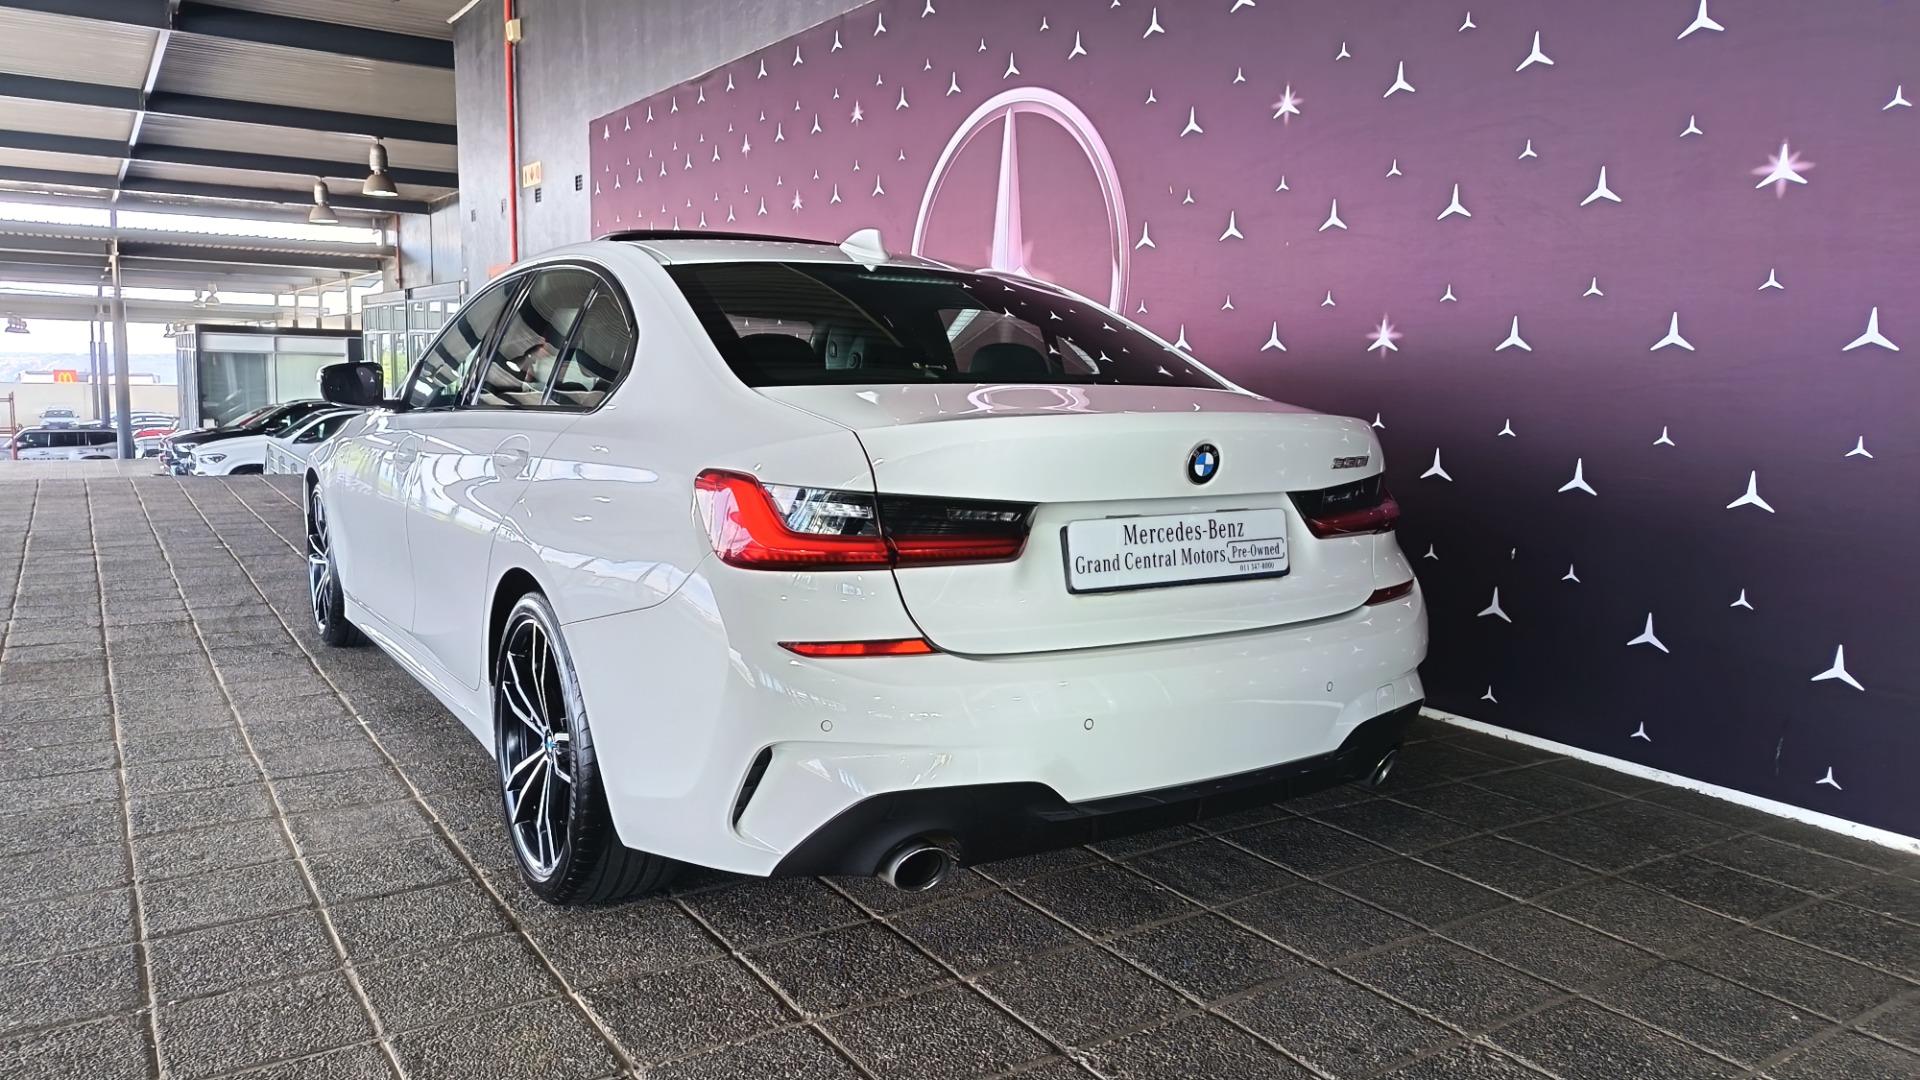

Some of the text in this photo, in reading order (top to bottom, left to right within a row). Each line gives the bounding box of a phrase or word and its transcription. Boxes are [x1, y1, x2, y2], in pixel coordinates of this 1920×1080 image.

[1123, 519, 1244, 546] Mercedes-Benz
[1075, 547, 1226, 574] Grand Central Motors
[1231, 542, 1280, 558] Pre-Owned
